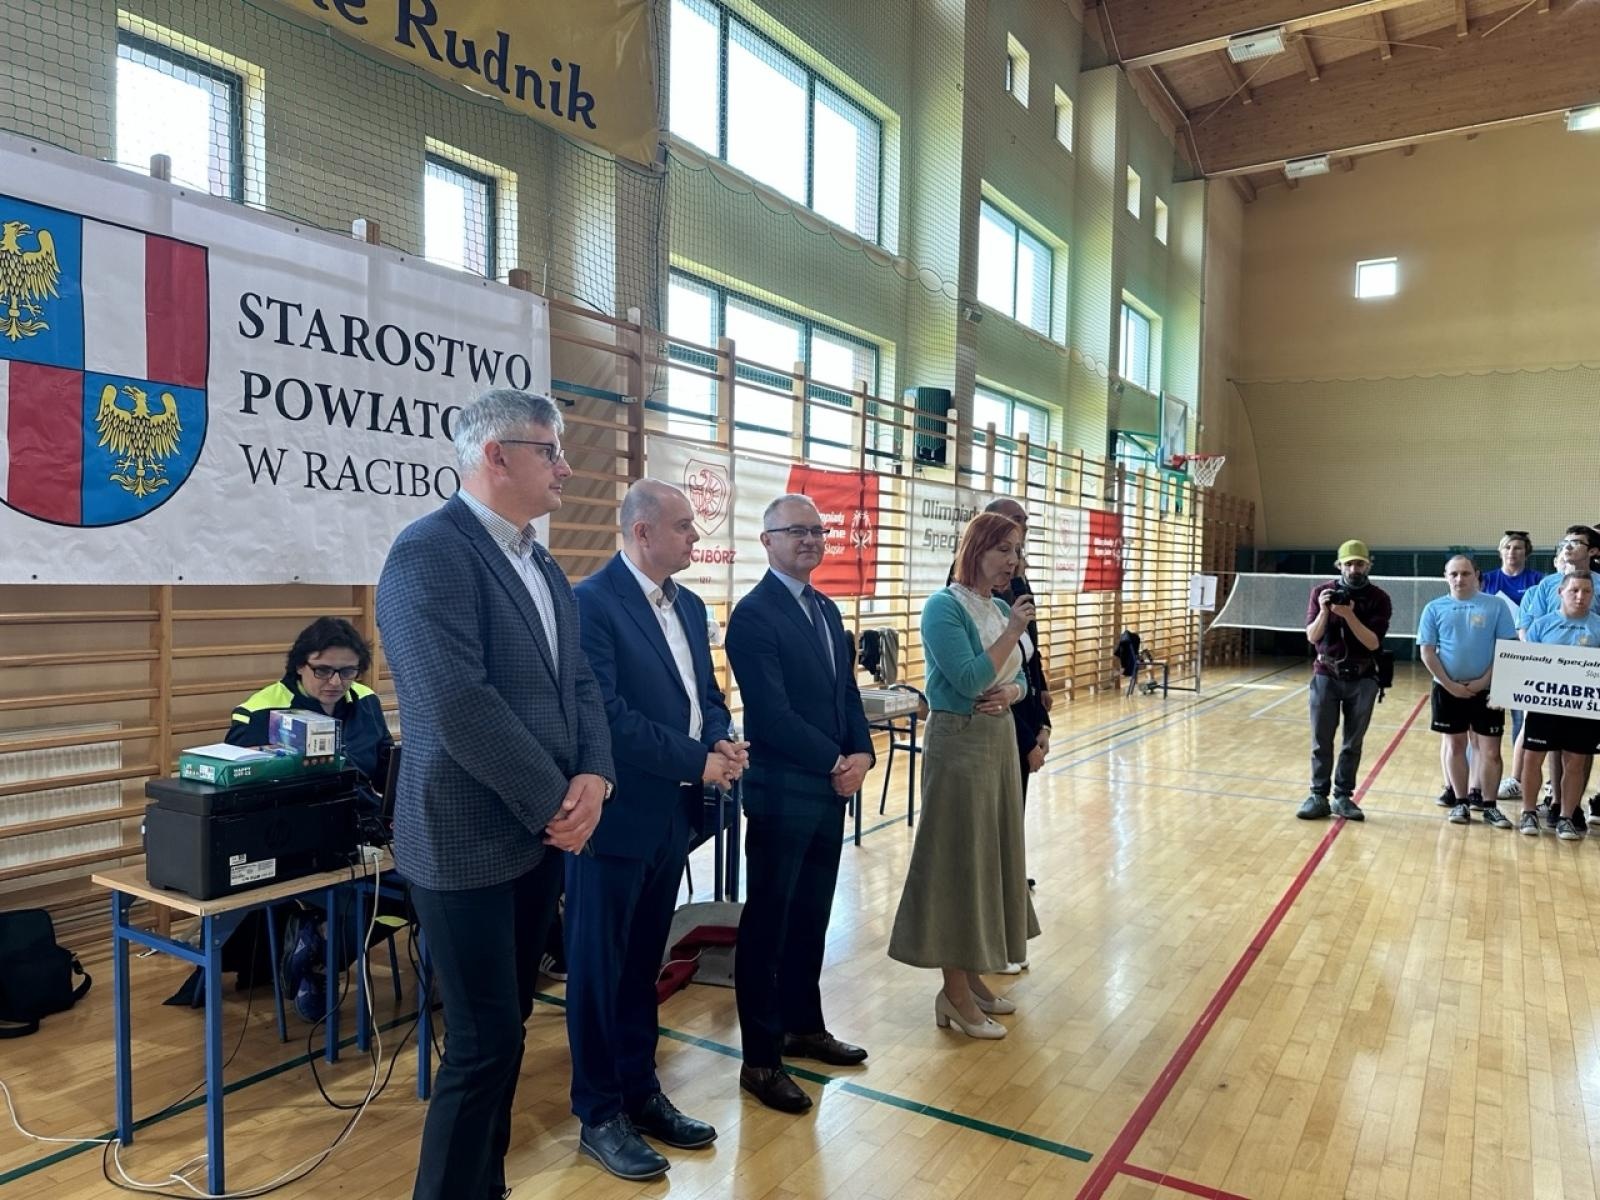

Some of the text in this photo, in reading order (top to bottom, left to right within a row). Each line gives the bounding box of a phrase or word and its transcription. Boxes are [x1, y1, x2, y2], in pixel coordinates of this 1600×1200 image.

[395, 0, 597, 129] Rudnik
[238, 292, 532, 391] STAROSTWO
[239, 370, 463, 442] POWIATO
[239, 444, 461, 500] W RACIBO
[922, 499, 979, 526] Olimpiad
[690, 545, 737, 565] CIBÓRZ
[1499, 652, 1553, 665] Olimpiady
[1513, 692, 1583, 710] WODZISŁAW
